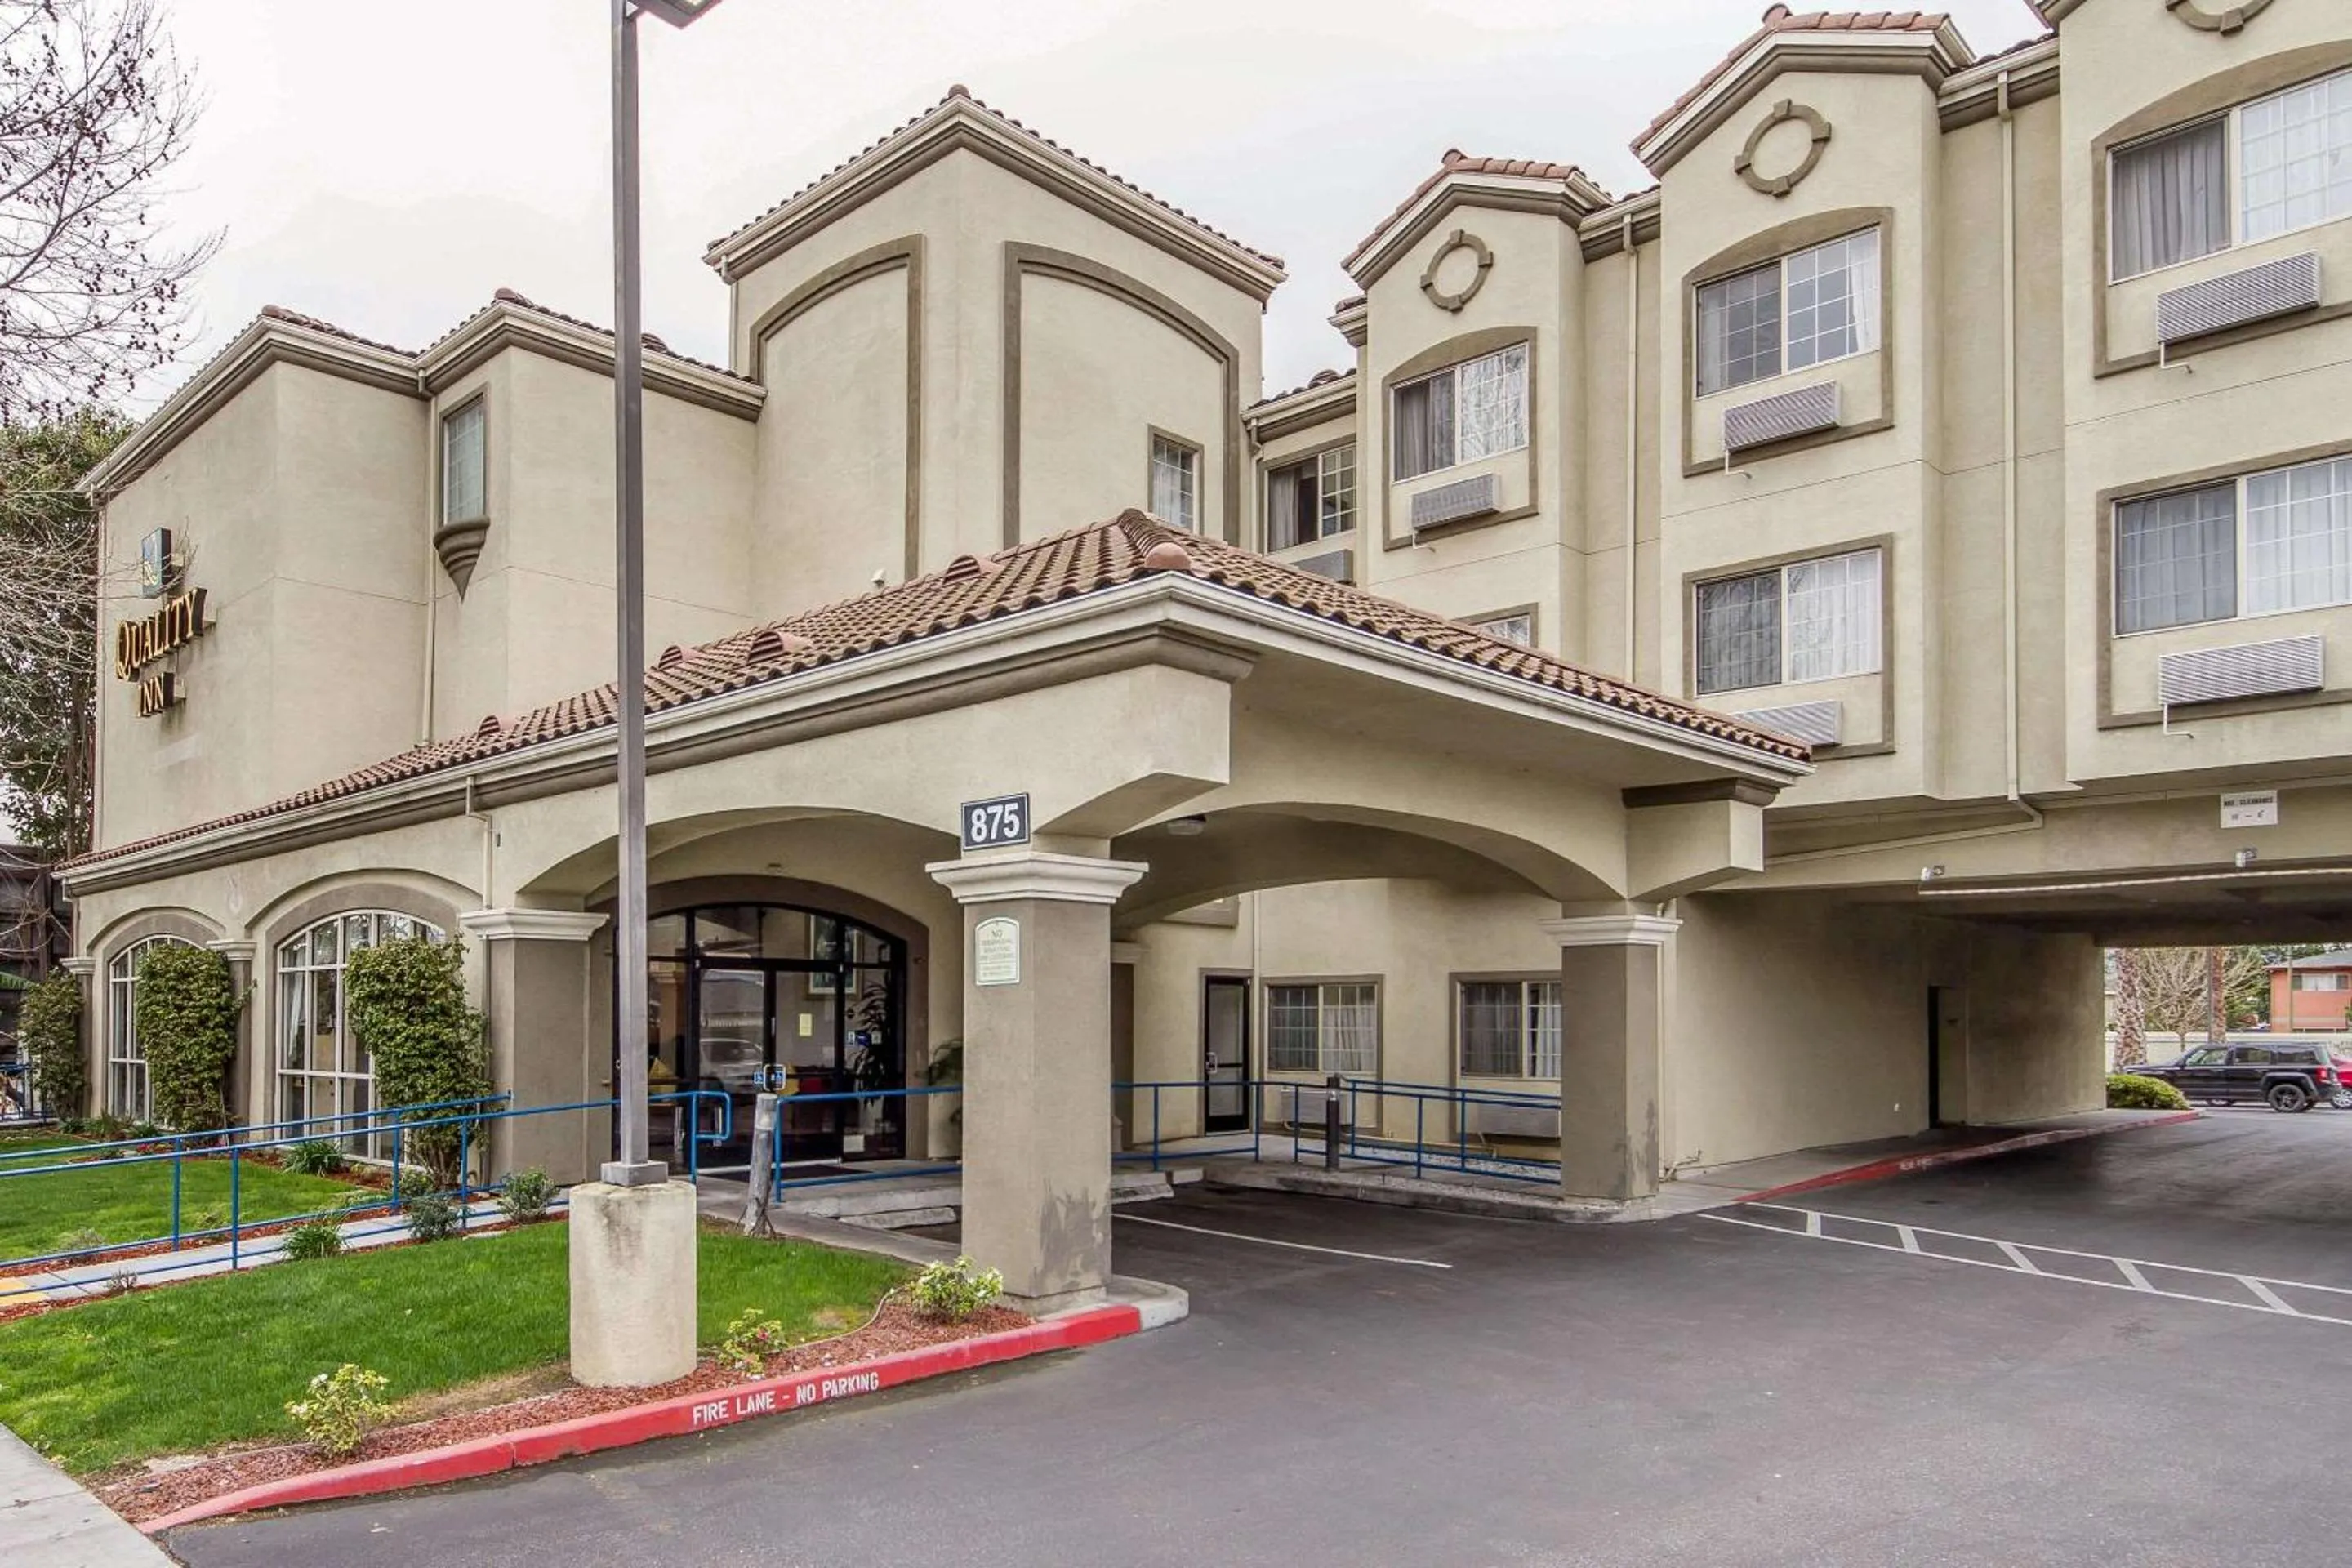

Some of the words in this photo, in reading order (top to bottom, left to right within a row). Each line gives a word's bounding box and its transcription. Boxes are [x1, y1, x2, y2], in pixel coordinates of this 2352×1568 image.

[115, 587, 197, 681] QUALITY
[138, 672, 163, 717] INN
[971, 803, 1020, 842] 875
[693, 1399, 729, 1425] FIRE
[736, 1391, 775, 1415] LANE
[796, 1383, 816, 1405] NO
[822, 1372, 879, 1399] PARKING
